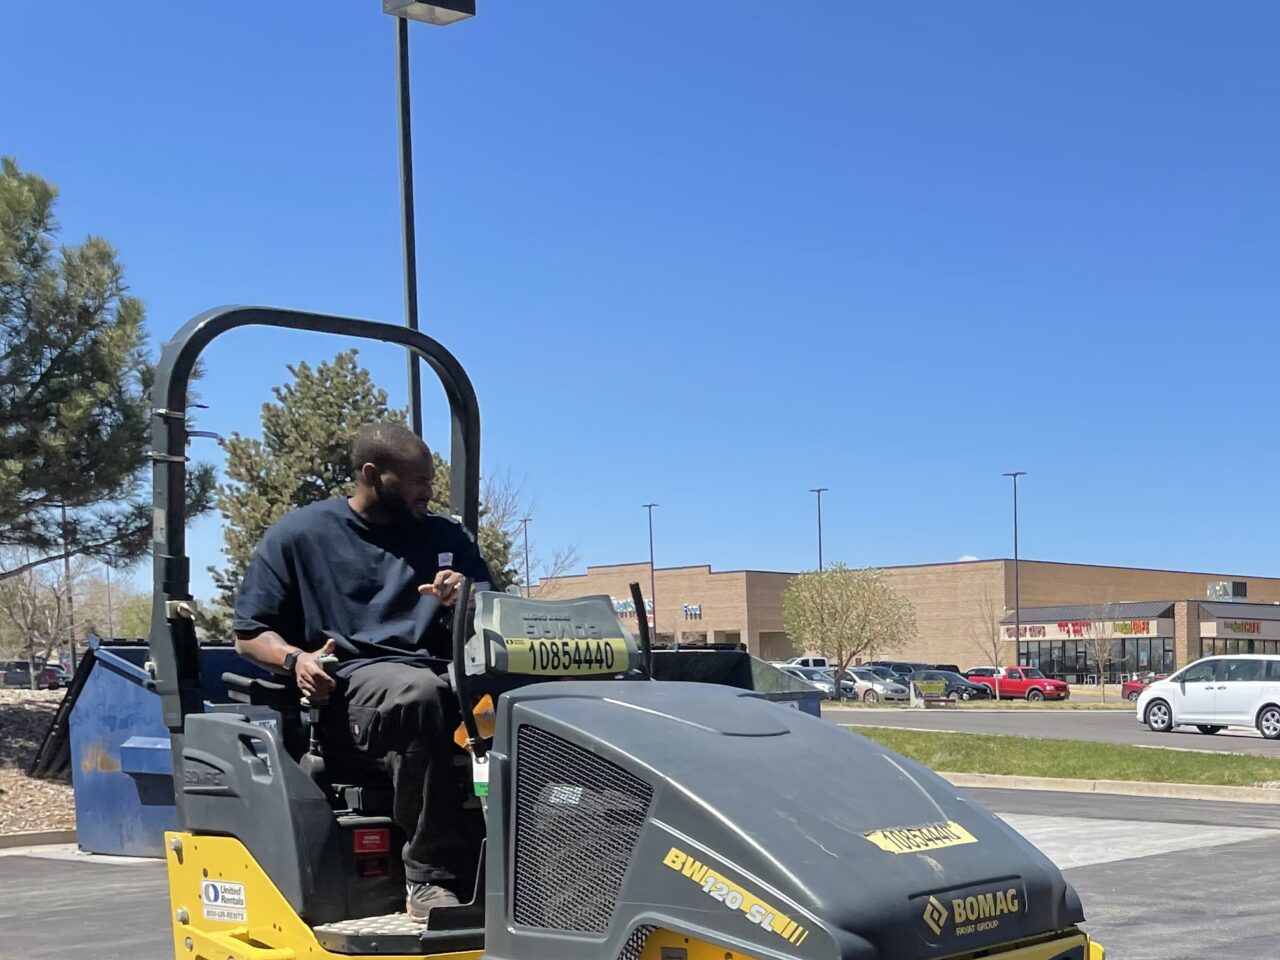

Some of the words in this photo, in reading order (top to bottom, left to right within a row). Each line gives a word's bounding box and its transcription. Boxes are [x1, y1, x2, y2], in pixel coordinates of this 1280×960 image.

[529, 641, 614, 670] 10854440
[220, 885, 242, 896] United
[221, 895, 244, 906] Rentals
[952, 888, 1019, 924] BOMAG
[745, 904, 775, 932] SL
[955, 924, 975, 936] FAYAT
[976, 920, 999, 932] GROUP
